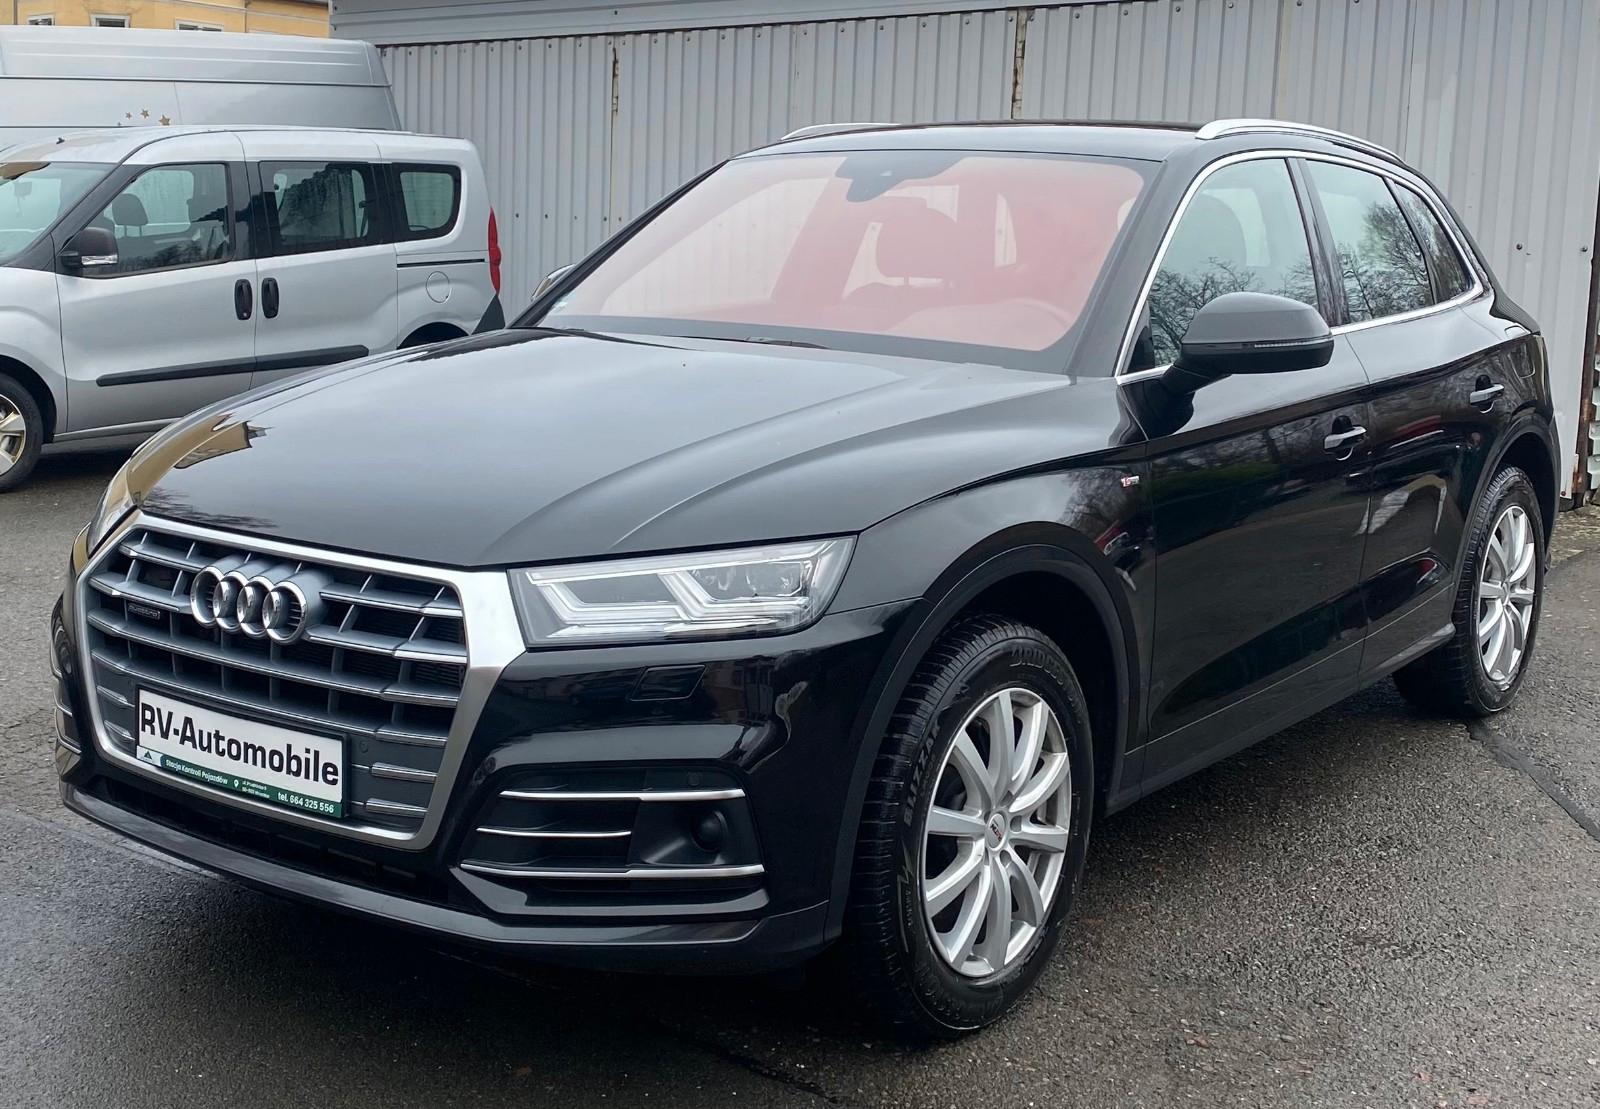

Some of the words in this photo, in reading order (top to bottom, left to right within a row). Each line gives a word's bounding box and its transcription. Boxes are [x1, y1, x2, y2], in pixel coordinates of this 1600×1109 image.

[141, 703, 339, 786] RV-Automobile
[165, 759, 182, 771] Stacja
[182, 765, 201, 777] Kontroli
[202, 771, 228, 784] Pojazdów
[278, 792, 289, 802] tel.
[289, 795, 304, 807] 664
[304, 799, 319, 810] 325
[319, 802, 334, 814] 556
